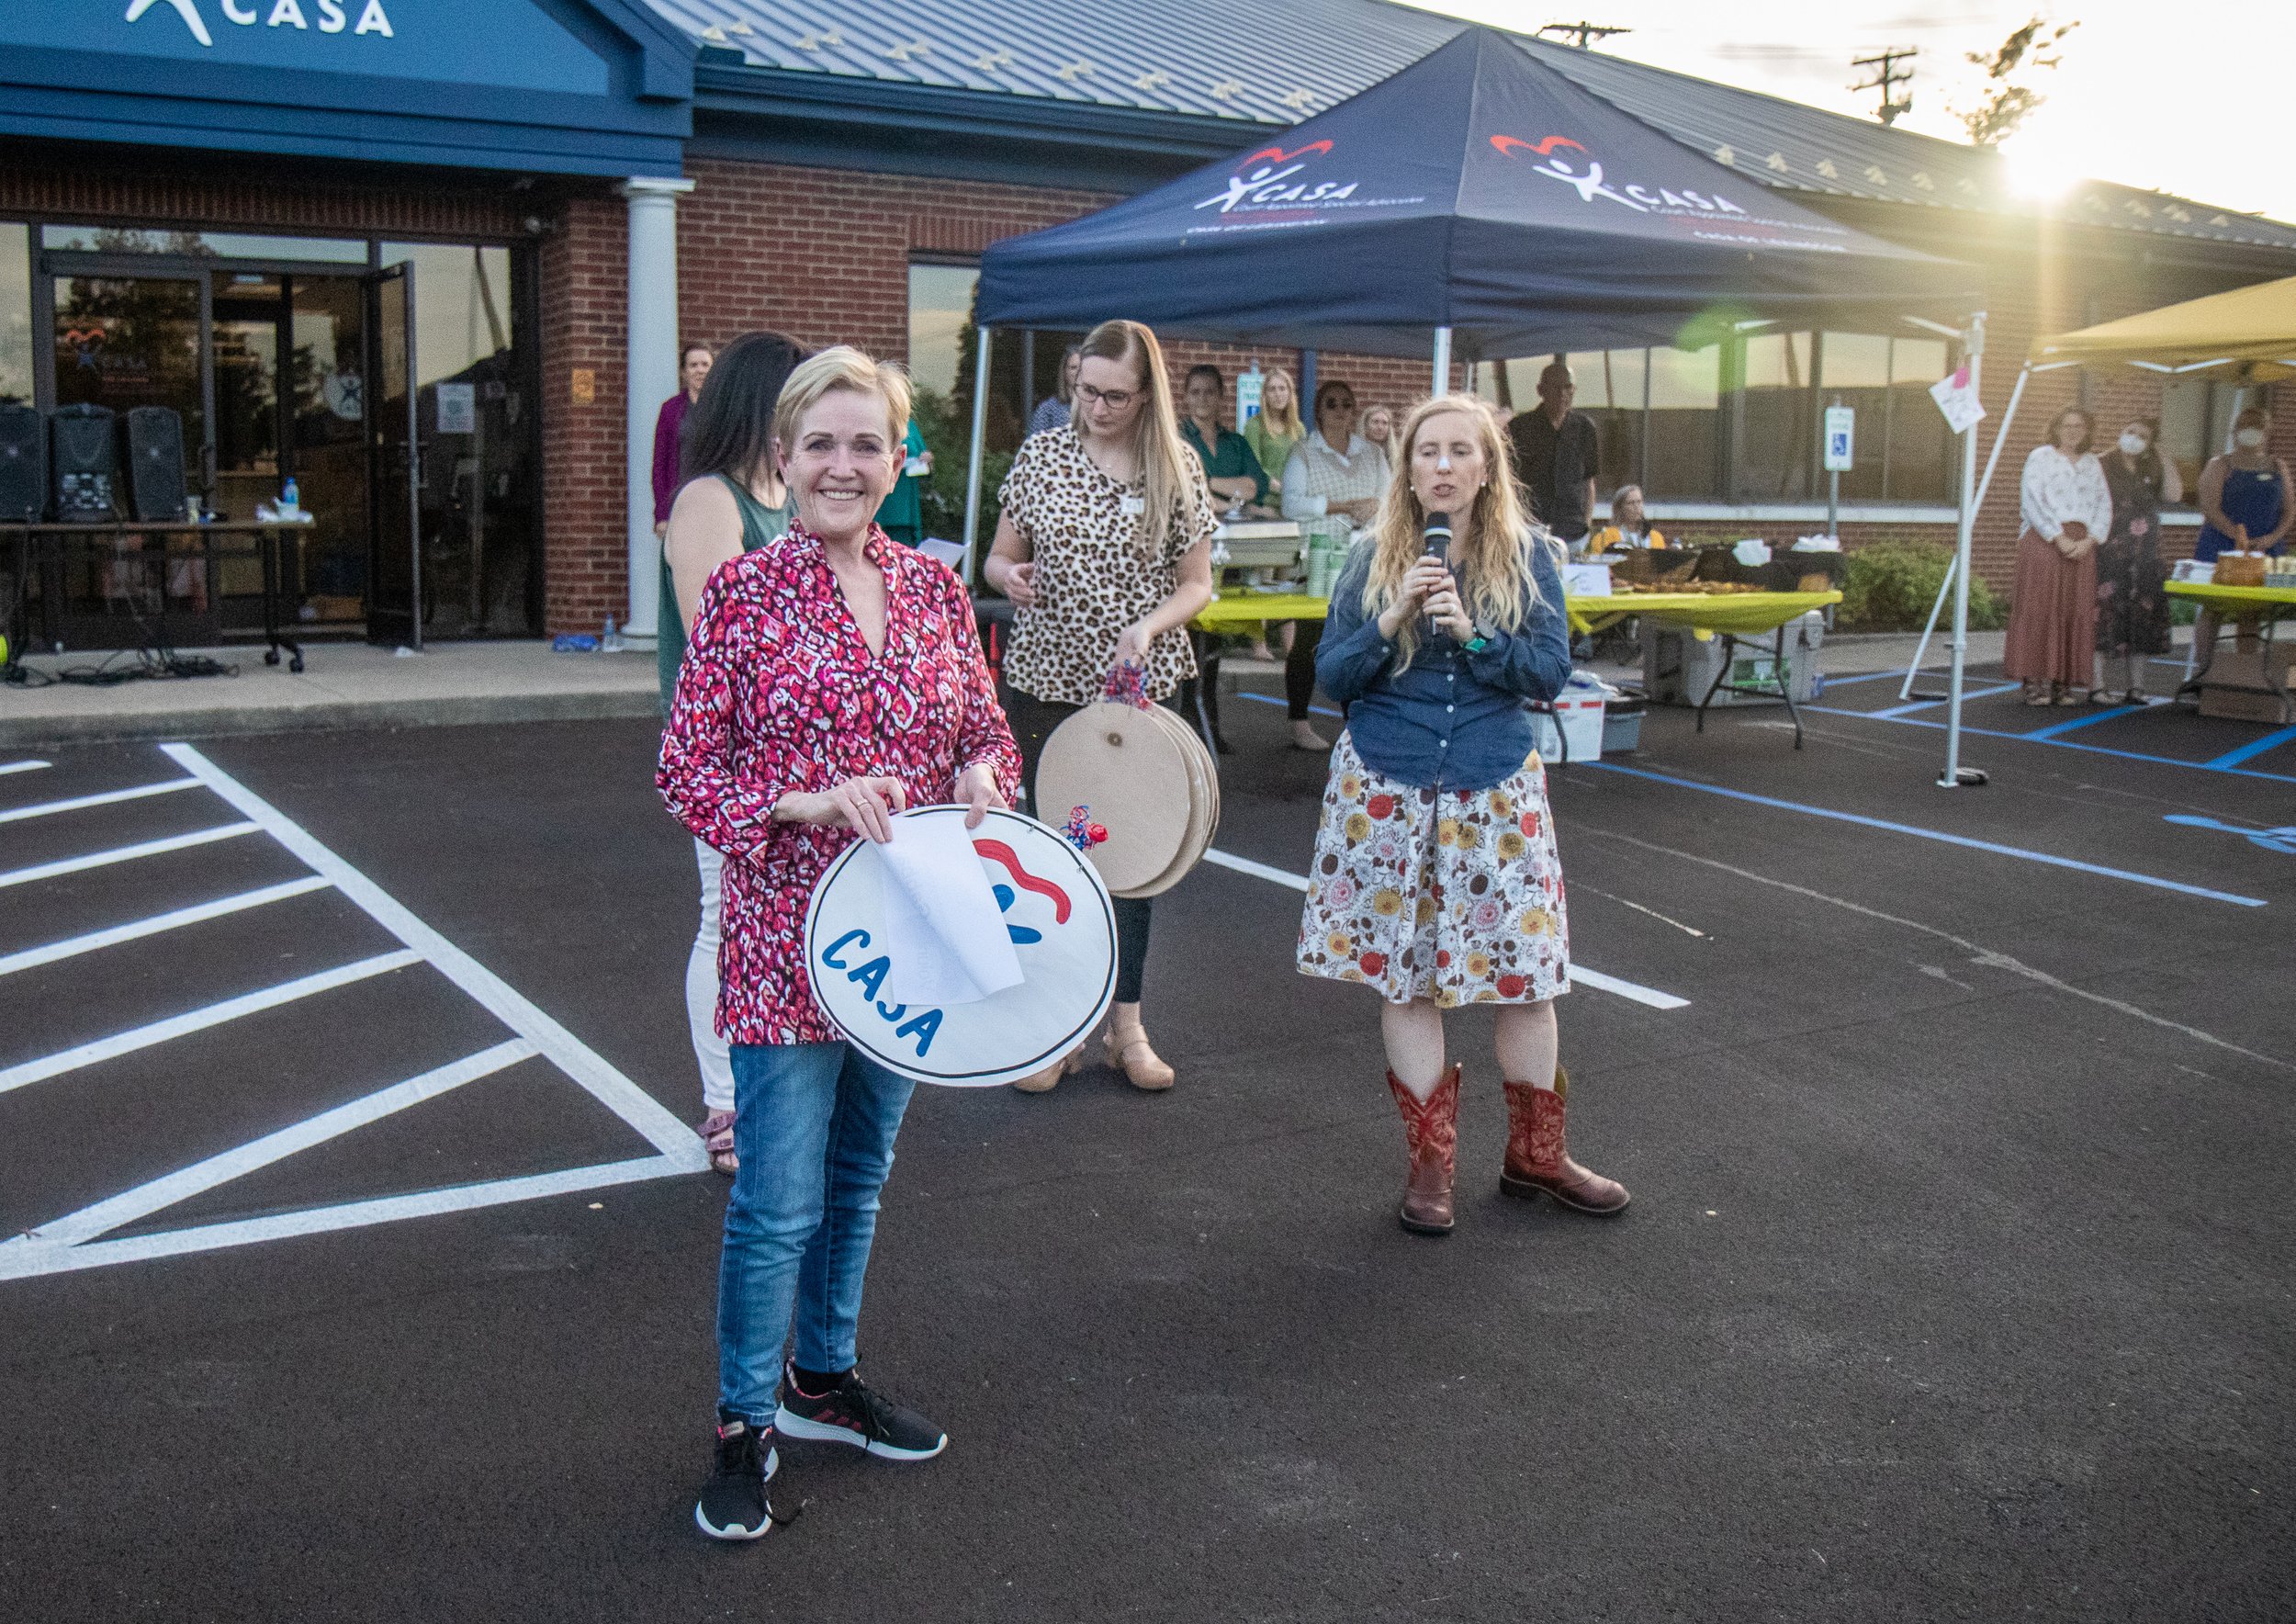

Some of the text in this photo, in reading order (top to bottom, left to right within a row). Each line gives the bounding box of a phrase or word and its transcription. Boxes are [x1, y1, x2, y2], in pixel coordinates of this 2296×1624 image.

[221, 0, 394, 38] CASA
[1252, 182, 1359, 204] CASA
[1625, 184, 1745, 214] CASA
